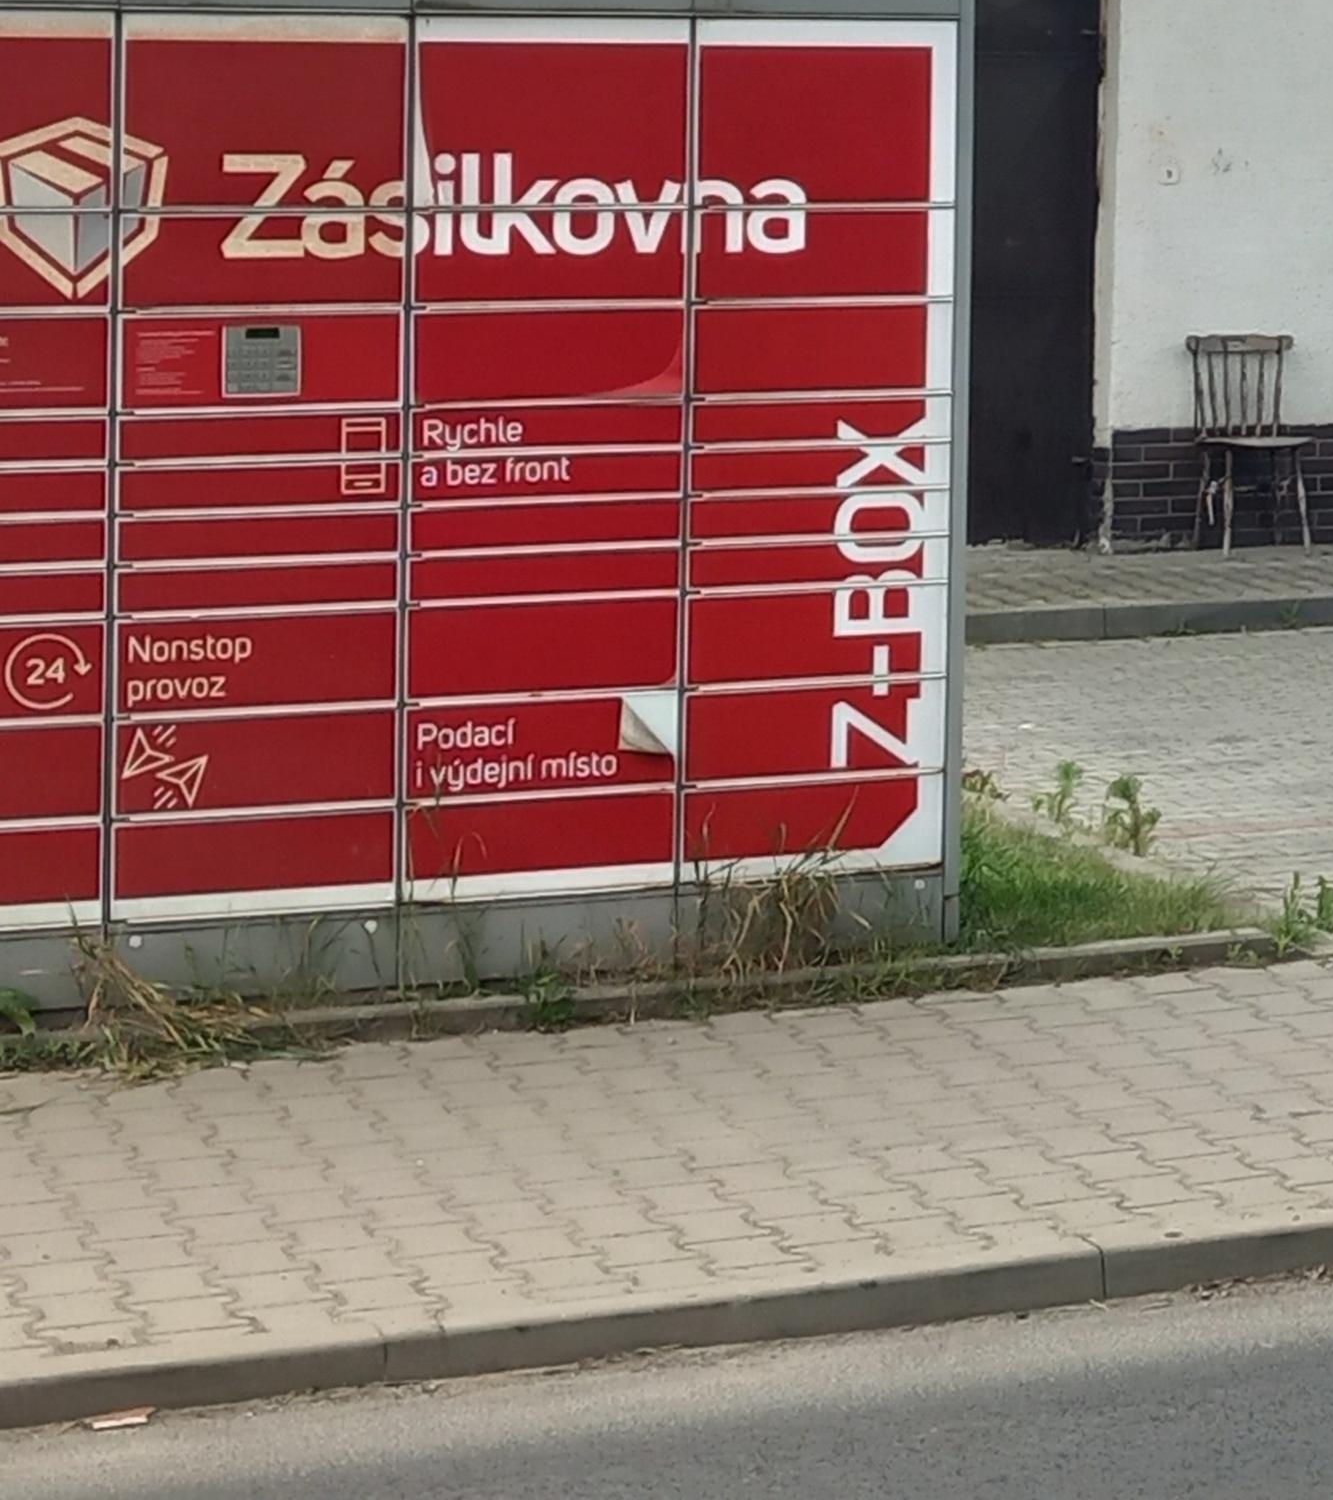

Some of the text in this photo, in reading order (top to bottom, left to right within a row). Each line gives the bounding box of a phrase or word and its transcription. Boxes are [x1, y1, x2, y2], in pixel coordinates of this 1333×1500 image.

[220, 151, 808, 261] Zásilkovna
[423, 416, 523, 451] Rychle
[420, 457, 570, 487] a bez front
[830, 418, 926, 771] Z-BOX
[127, 634, 252, 664] Nonstop
[25, 657, 65, 685] 24
[127, 676, 226, 708] provoz
[417, 718, 516, 750] Podací
[415, 752, 618, 792] i výdejní místo
